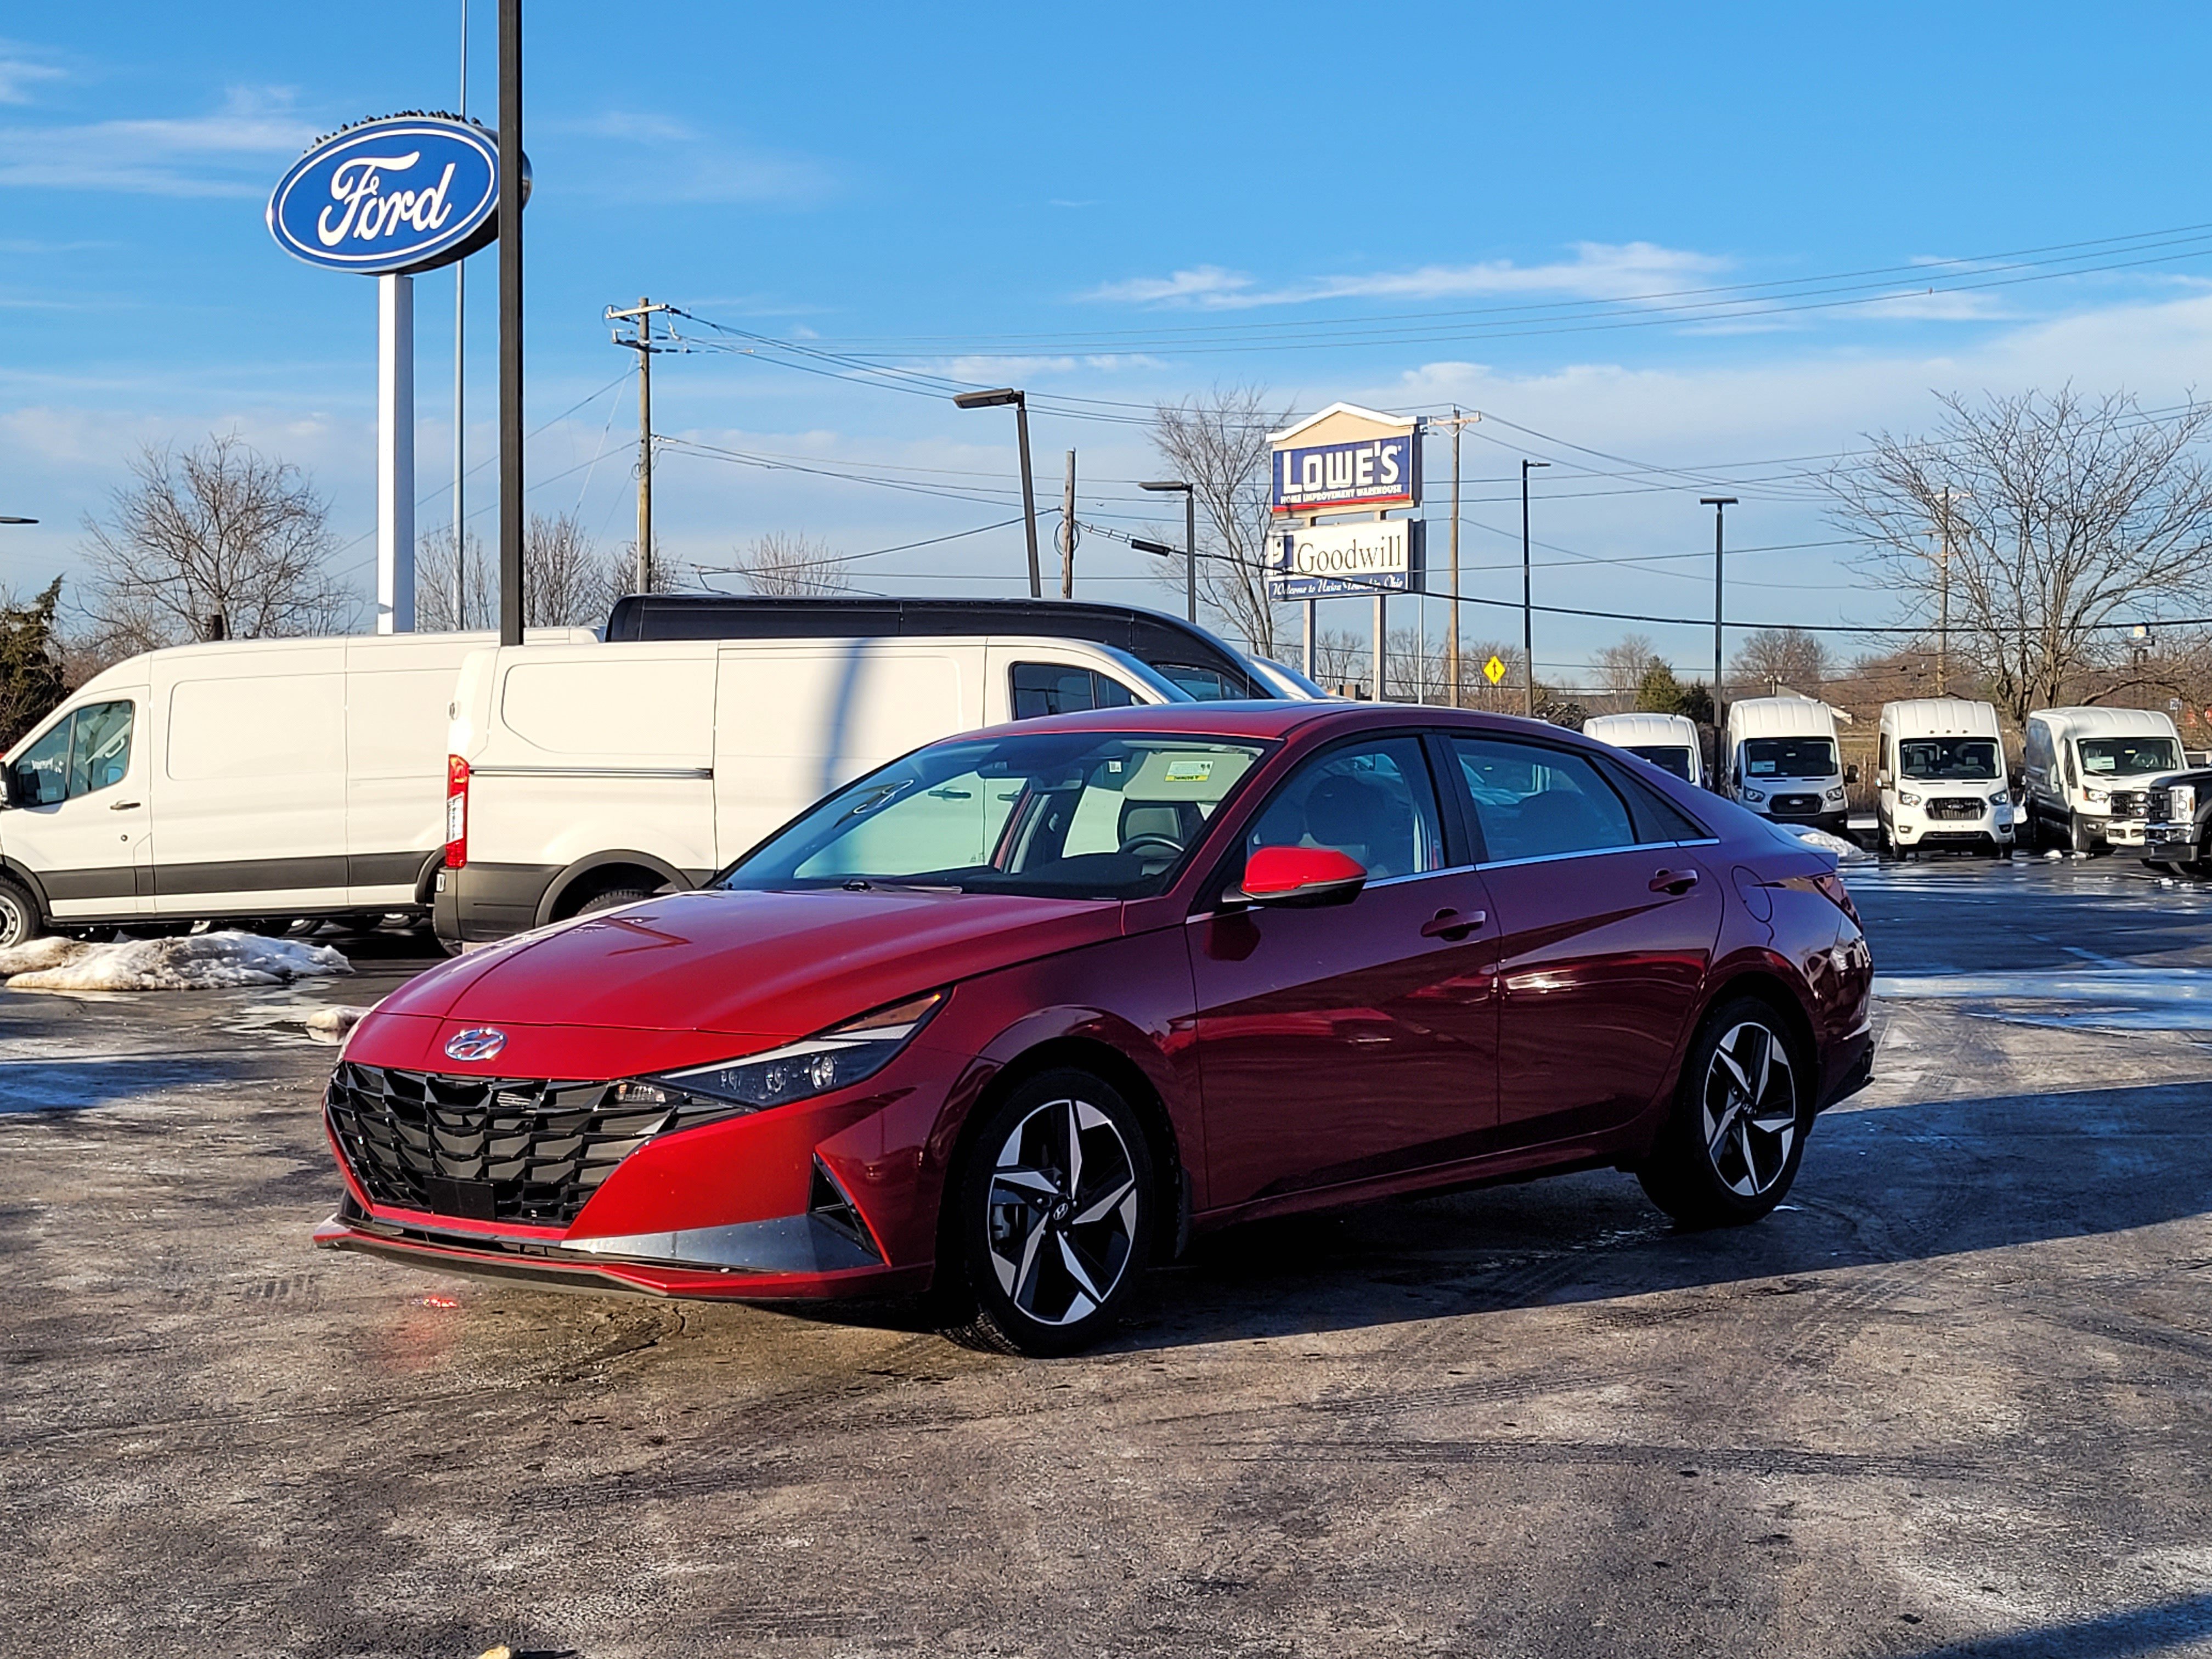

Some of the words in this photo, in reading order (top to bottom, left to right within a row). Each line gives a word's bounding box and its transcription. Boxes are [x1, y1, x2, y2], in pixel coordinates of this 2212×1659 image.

[318, 151, 455, 246] Ford
[1283, 441, 1400, 494] LOWE'S
[1297, 534, 1401, 573] Goodwill
[1272, 582, 1307, 596] Wlcome
[1308, 584, 1316, 593] to
